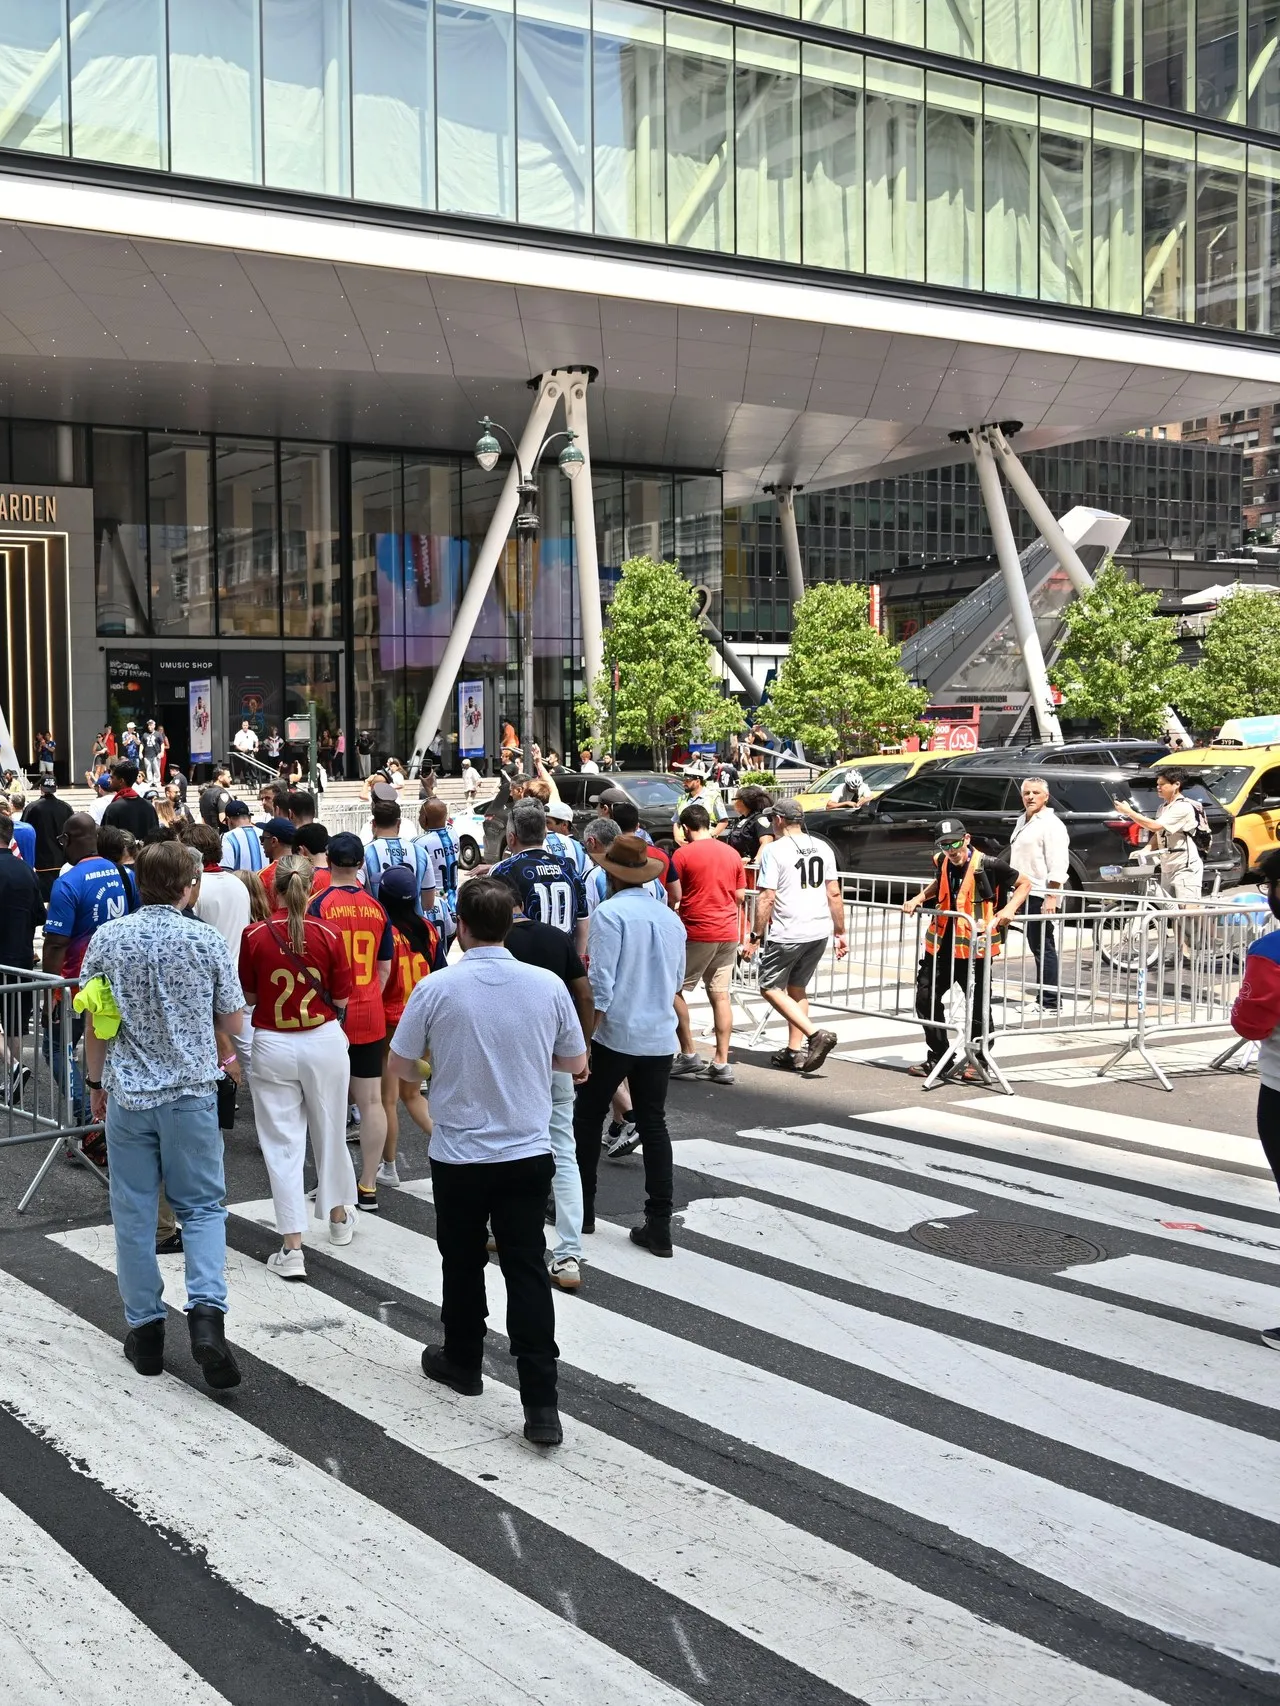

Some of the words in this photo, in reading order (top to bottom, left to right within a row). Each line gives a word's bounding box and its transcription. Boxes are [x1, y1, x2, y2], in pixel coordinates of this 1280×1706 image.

[385, 847, 407, 857] MESSI
[434, 843, 459, 860] MESS
[546, 843, 568, 853] MESSI
[535, 864, 562, 876] MESSI
[794, 856, 824, 889] 10
[325, 905, 357, 920] LAMINE
[533, 881, 572, 933] 10
[270, 967, 326, 1029] 22
